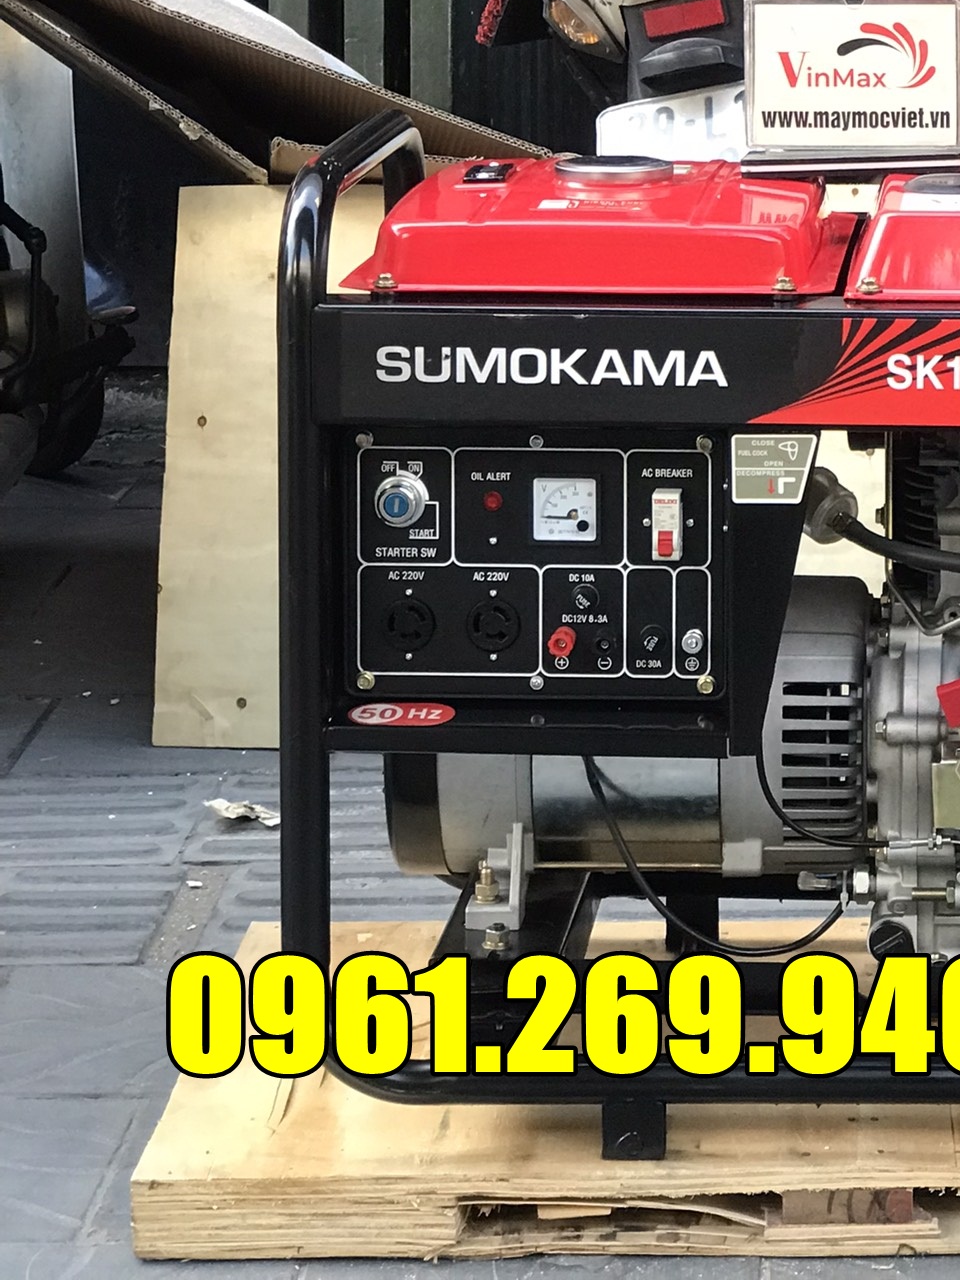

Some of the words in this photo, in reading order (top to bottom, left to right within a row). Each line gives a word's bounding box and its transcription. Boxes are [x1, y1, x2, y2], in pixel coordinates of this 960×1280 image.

[777, 51, 888, 89] VinMax
[761, 107, 951, 132] www.maymocviet.vn
[375, 345, 729, 388] SUMOKAMA
[751, 439, 775, 447] CLOSE
[381, 463, 395, 473] OFF
[408, 463, 420, 473] ON
[641, 468, 653, 478] AC
[655, 468, 693, 478] BREAKER
[471, 472, 485, 481] OIL
[486, 472, 511, 482] ALERT
[409, 529, 434, 538] START
[375, 547, 419, 558] STARTER
[420, 547, 437, 558] SW
[388, 571, 400, 580] AC
[402, 571, 425, 581] 220V
[473, 571, 485, 581] AC
[486, 572, 510, 582] 220V
[569, 573, 580, 582] DC
[581, 573, 595, 582] 10A
[635, 659, 646, 668] DC
[647, 659, 662, 668] 30A
[359, 707, 400, 720] 50
[408, 707, 442, 720] Hz
